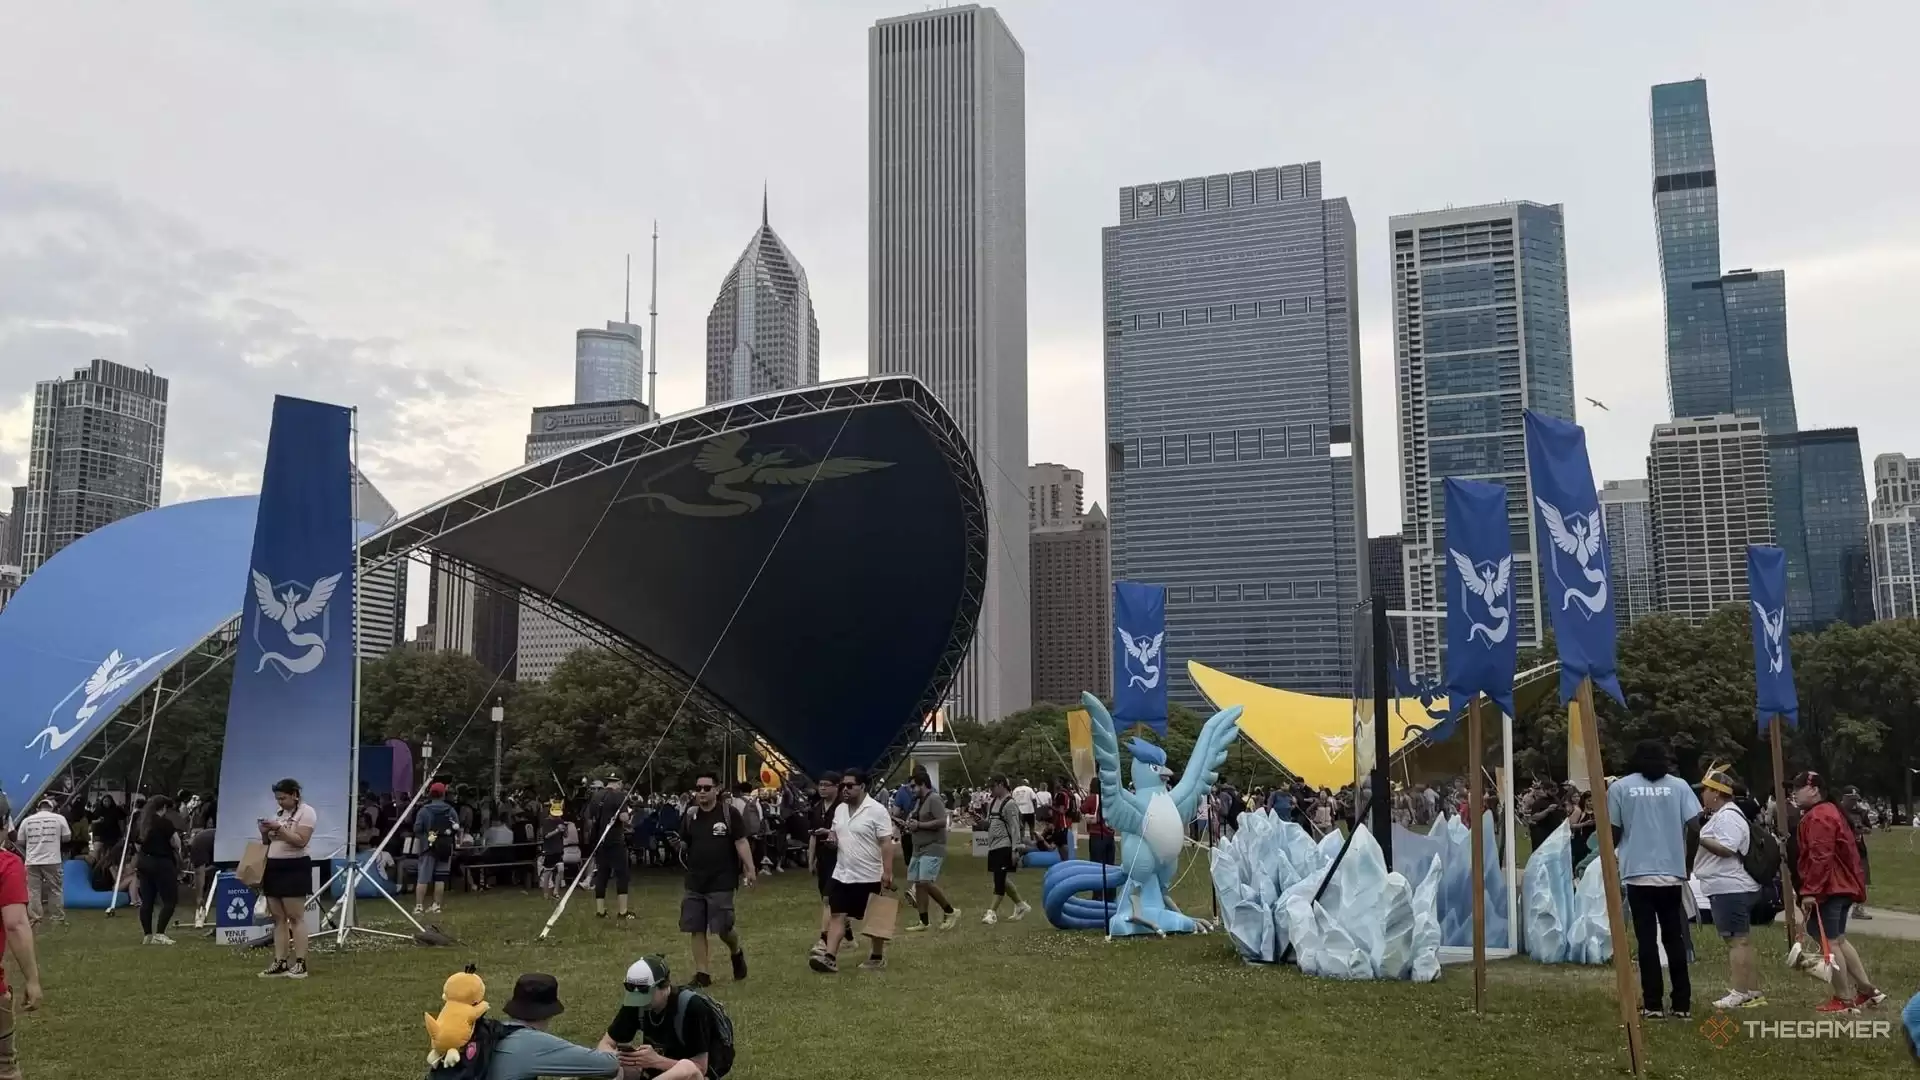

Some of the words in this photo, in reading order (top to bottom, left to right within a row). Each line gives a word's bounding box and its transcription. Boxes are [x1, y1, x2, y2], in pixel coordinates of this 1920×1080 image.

[560, 408, 619, 425] Prudential
[1629, 786, 1671, 797] STAFF
[224, 929, 246, 937] VENUE
[227, 936, 249, 945] SMART
